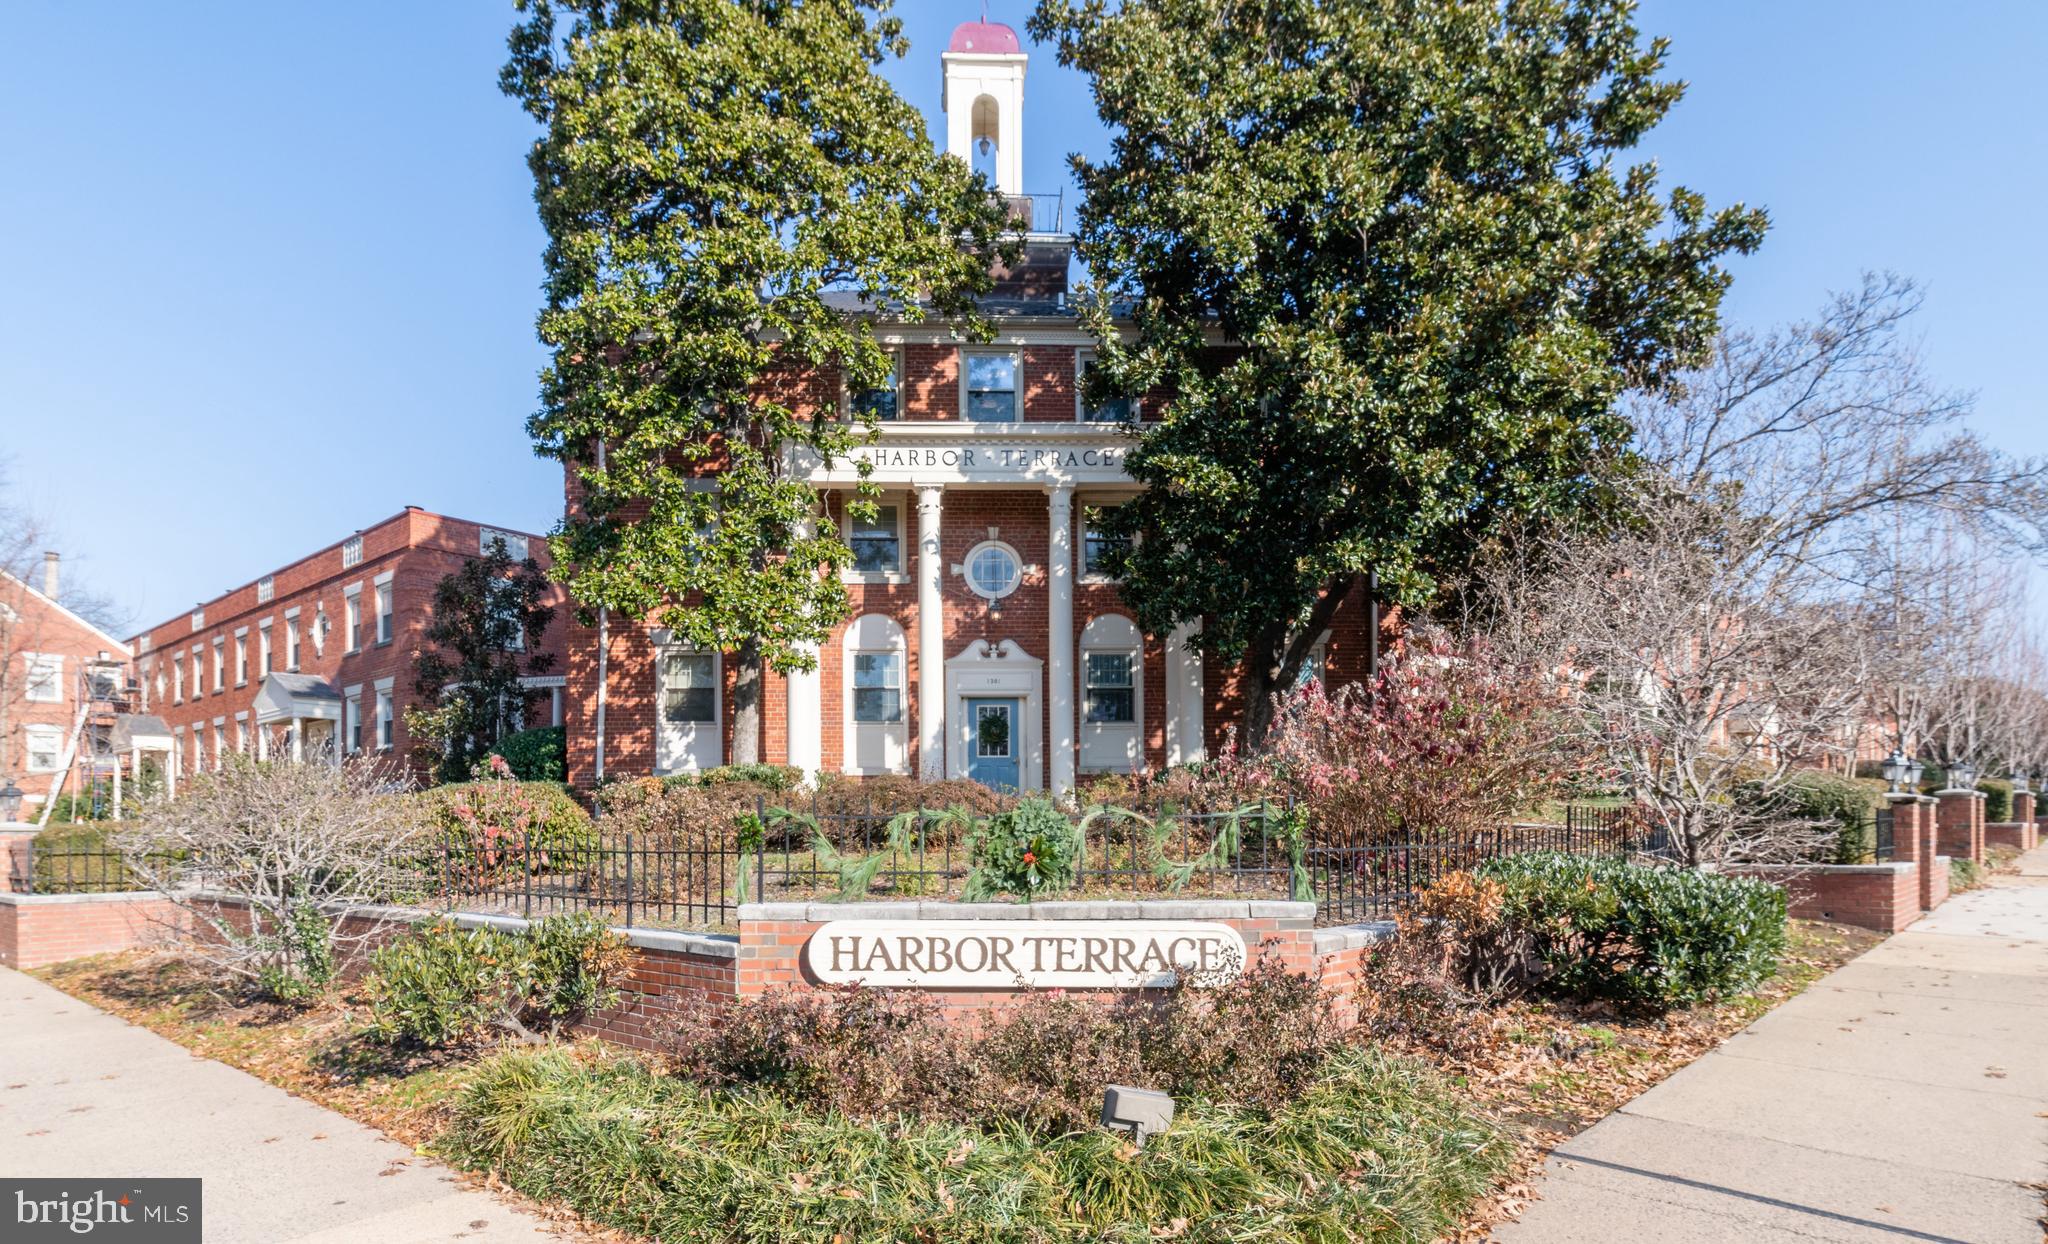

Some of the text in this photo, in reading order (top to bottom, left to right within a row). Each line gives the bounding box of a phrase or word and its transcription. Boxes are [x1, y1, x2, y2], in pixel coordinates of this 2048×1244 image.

[875, 449, 1115, 467] HARBOR TERRACE
[829, 936, 1228, 975] HARBOR TERRACE
